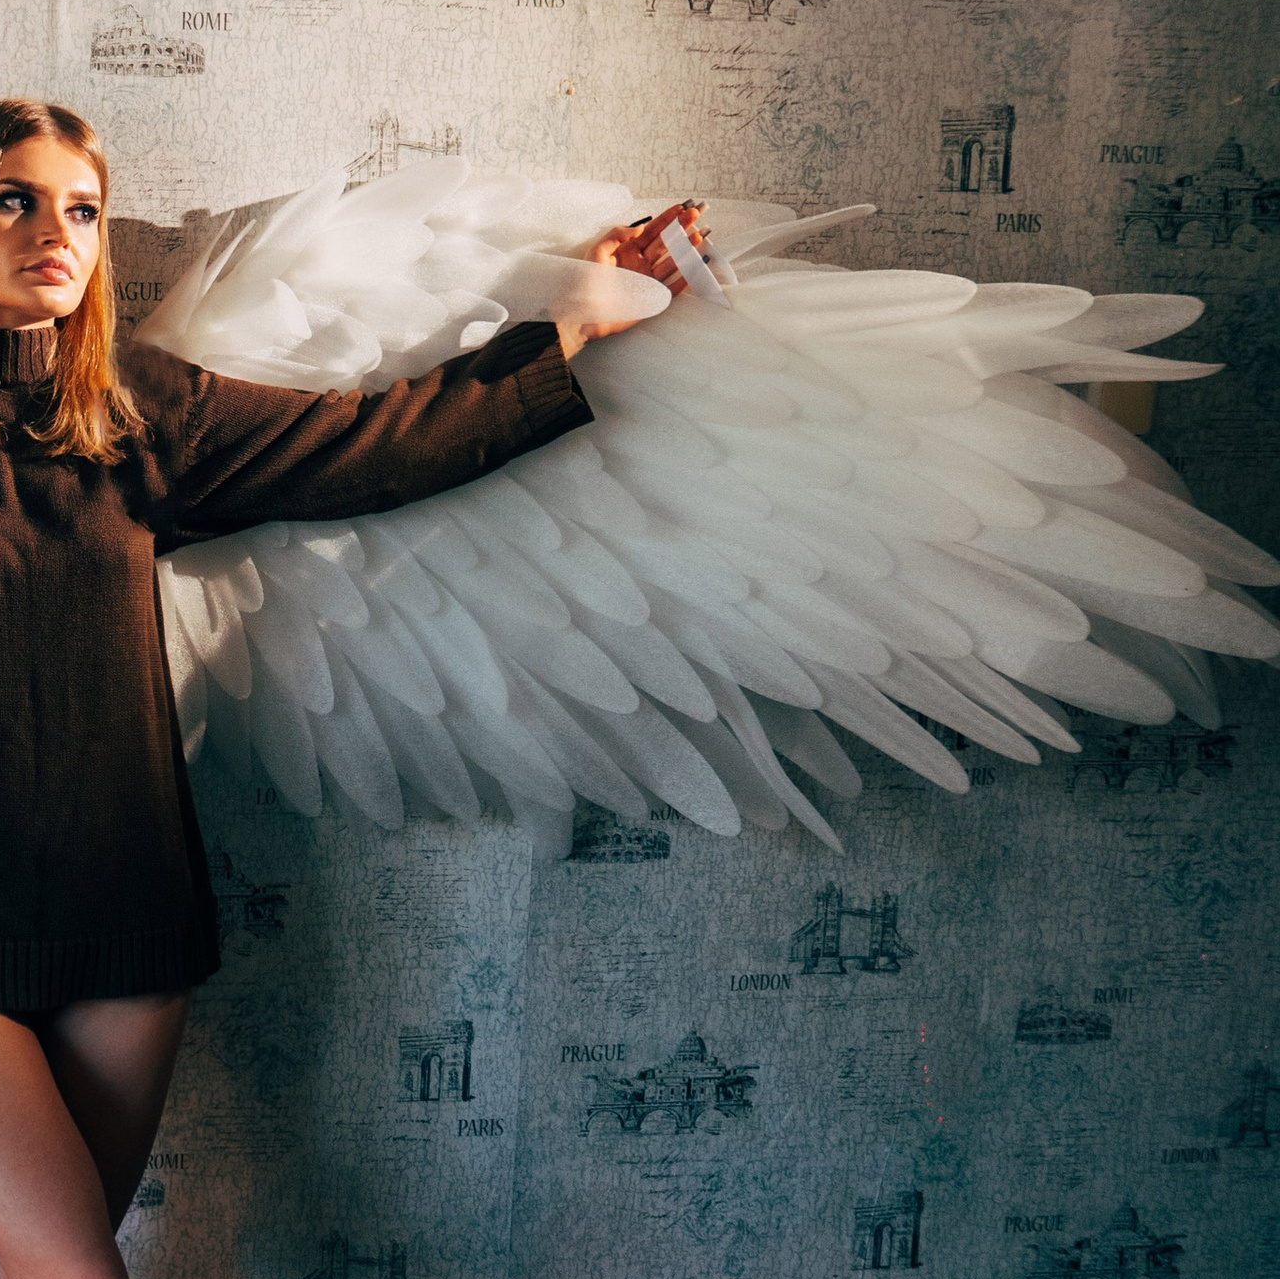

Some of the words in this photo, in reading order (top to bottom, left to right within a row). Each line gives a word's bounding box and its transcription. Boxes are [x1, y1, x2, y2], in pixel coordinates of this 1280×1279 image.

[181, 11, 233, 32] ROME
[1100, 143, 1165, 165] PRAGUE
[996, 213, 1042, 235] PARIS
[116, 282, 163, 302] AGUE
[729, 974, 793, 993] LONDON
[1094, 988, 1137, 1006] ROME
[560, 1044, 626, 1064] PRAGUE
[457, 1118, 504, 1138] PARIS
[1161, 1149, 1221, 1166] LONDON
[1003, 1215, 1064, 1234] PRAGUE
